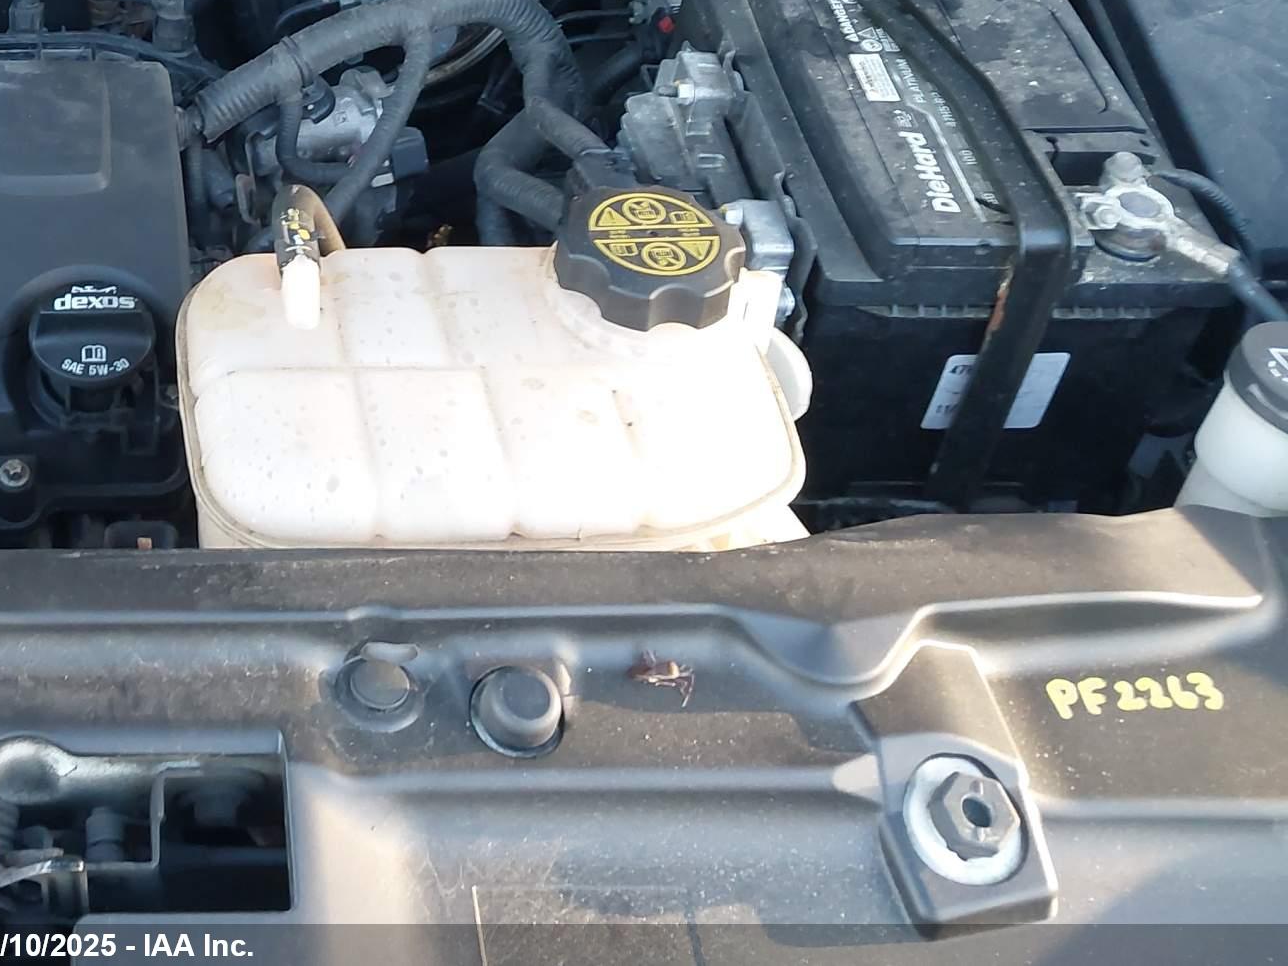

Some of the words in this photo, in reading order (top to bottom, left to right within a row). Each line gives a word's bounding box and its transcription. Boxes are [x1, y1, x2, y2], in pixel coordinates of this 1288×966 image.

[898, 131, 961, 213] DieHard
[53, 292, 136, 311] dexos
[61, 358, 85, 375] SAE
[88, 358, 130, 376] 5W-30
[1045, 676, 1107, 720] PF
[1113, 671, 1224, 711] 2263
